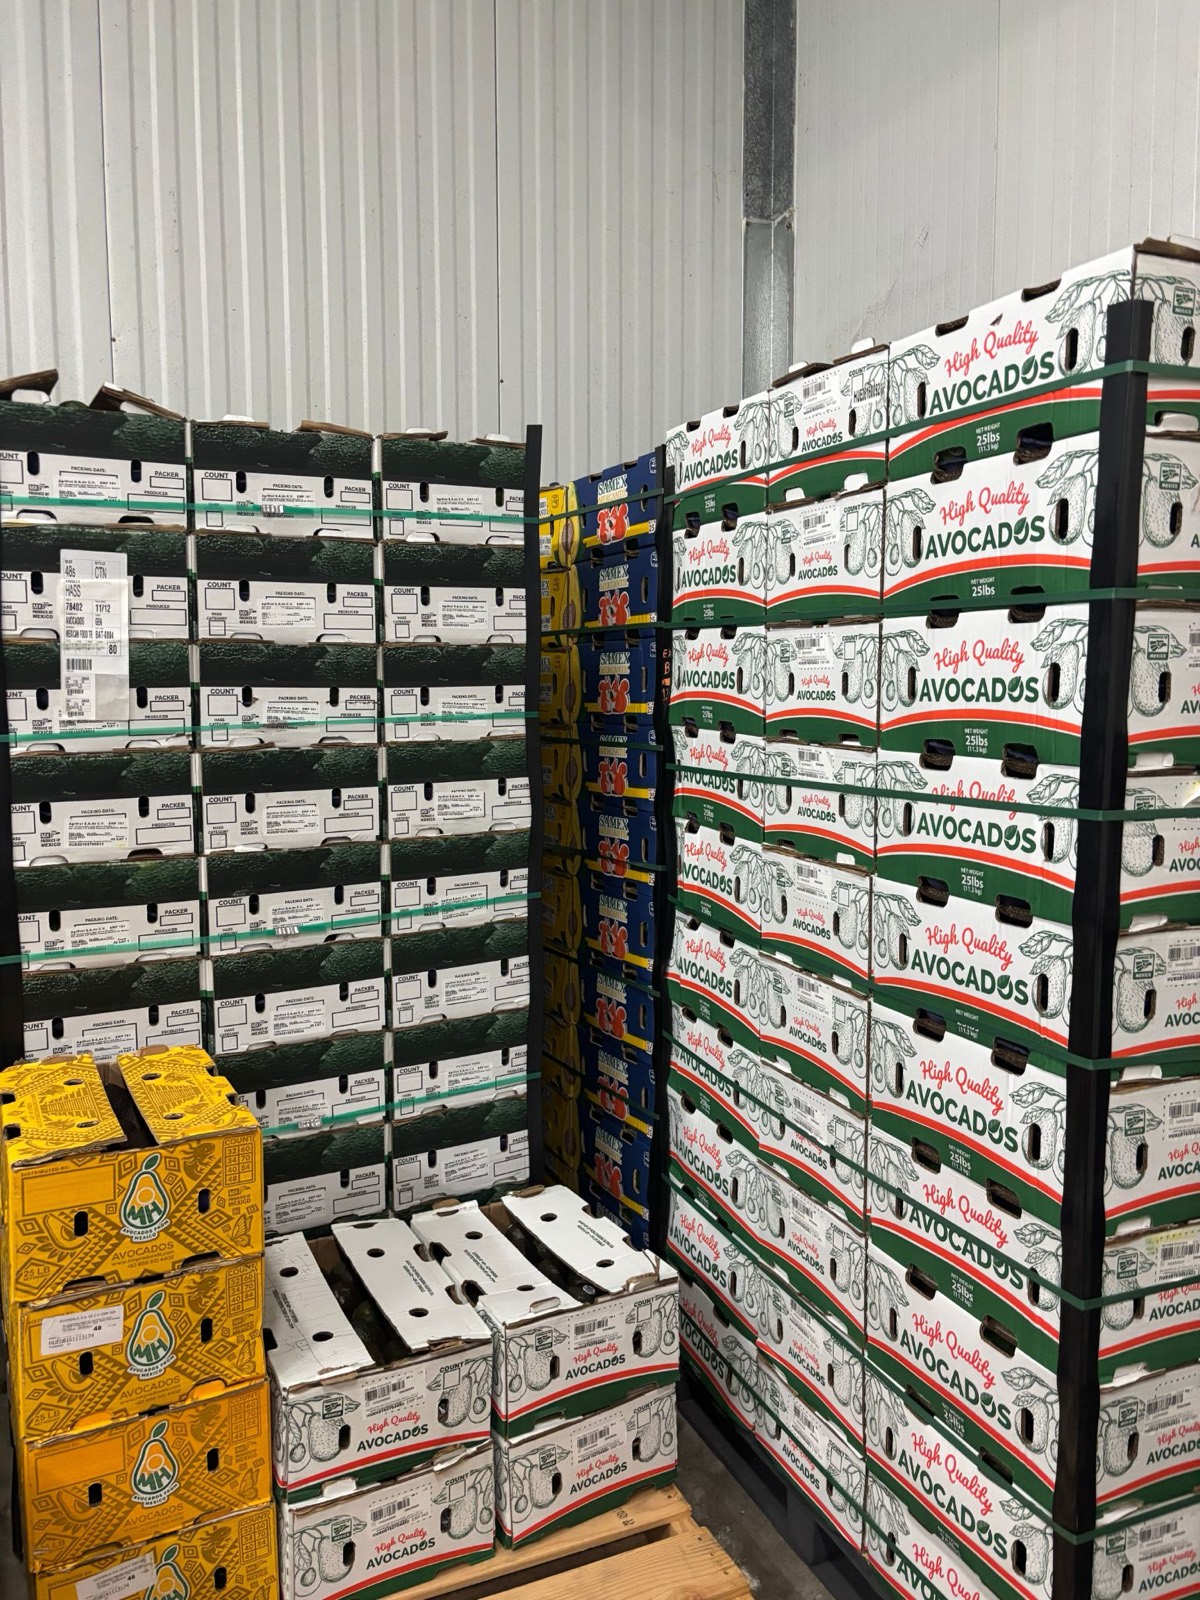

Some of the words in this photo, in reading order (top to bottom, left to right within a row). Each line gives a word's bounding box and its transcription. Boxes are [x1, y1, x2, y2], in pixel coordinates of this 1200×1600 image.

[944, 337, 981, 377] High
[982, 319, 1039, 359] Quality
[848, 366, 866, 377] COUNT
[929, 351, 1054, 415] AVOCADOS
[806, 423, 818, 437] High
[819, 418, 837, 432] Quality
[976, 432, 1001, 445] 25lbs
[691, 433, 706, 457] High
[707, 424, 732, 451] Quality
[801, 431, 843, 453] AVOCADOS
[683, 449, 738, 483] AVOCADOS
[598, 474, 627, 495] SAMEX
[844, 505, 861, 513] COUNT
[939, 497, 976, 526] High
[977, 480, 1030, 516] Quality
[925, 515, 1045, 560] AVOCADOS
[688, 545, 706, 566] High
[707, 538, 730, 562] Quality
[802, 553, 814, 566] High
[814, 550, 832, 563] Quality
[95, 566, 107, 579] CTN
[681, 564, 736, 588] AVOCADOS
[798, 565, 838, 581] AVOCADOS
[66, 584, 80, 598] HASS
[971, 585, 996, 597] 25lbs
[66, 602, 82, 612] 78402
[95, 604, 110, 612] 11/12
[108, 644, 118, 654] 80
[688, 645, 705, 667] High
[706, 643, 730, 667] Quality
[933, 639, 969, 673] High
[972, 637, 1025, 673] Quality
[681, 669, 736, 690] AVOCADOS
[801, 676, 813, 688] High
[813, 674, 830, 688] Quality
[919, 675, 1040, 703] AVOCADOS
[797, 690, 836, 701] AVOCADOS
[965, 735, 988, 747] 25lbs
[689, 744, 705, 766] High
[706, 747, 729, 773] Quality
[801, 794, 813, 805] High
[813, 794, 831, 810] Quality
[797, 806, 837, 823] AVOCADOS
[916, 811, 1037, 854] AVOCADOS
[961, 874, 984, 889] 25lbs
[218, 898, 242, 906] COUNT
[796, 908, 808, 920] High
[808, 909, 826, 926] Quality
[792, 918, 831, 940] AVOCADOS
[685, 939, 704, 958] High
[704, 940, 727, 976] Quality
[925, 923, 959, 954] High
[961, 927, 1013, 972] Quality
[678, 957, 733, 999] AVOCADOS
[911, 949, 1029, 1006] AVOCADOS
[220, 999, 244, 1007] COUNT
[1176, 993, 1198, 1009] High
[788, 1026, 827, 1054] AVOCADOS
[920, 1060, 953, 1091] High
[955, 1066, 1004, 1116] Quality
[905, 1079, 1019, 1153] AVOCADOS
[224, 1136, 253, 1146] COUNT
[682, 1125, 699, 1149] High
[699, 1133, 722, 1171] Quality
[1168, 1143, 1188, 1161] High
[241, 1154, 250, 1162] 70
[398, 1156, 418, 1164] COUNT
[679, 1140, 729, 1197] AVOCADOS
[949, 1151, 972, 1170] 25lbs
[923, 1183, 955, 1216] High
[957, 1194, 1009, 1248] Quality
[112, 1242, 174, 1260] AVOCADOS
[38, 1266, 50, 1274] LB
[227, 1265, 256, 1276] COUNT
[951, 1279, 974, 1301] 25lbs
[634, 1296, 655, 1307] COUNT
[573, 1351, 593, 1364] High
[593, 1344, 619, 1358] Quality
[911, 1312, 943, 1346] High
[945, 1330, 996, 1389] Quality
[440, 1362, 464, 1373] COUNT
[565, 1354, 626, 1380] AVOCADOS
[120, 1376, 181, 1400] AVOCADOS
[900, 1329, 1012, 1431] AVOCADOS
[634, 1402, 653, 1414] COUNT
[367, 1420, 389, 1434] High
[391, 1411, 421, 1425] Quality
[357, 1424, 428, 1452] AVOCADOS
[576, 1465, 594, 1479] High
[594, 1454, 620, 1469] Quality
[911, 1432, 942, 1467] High
[944, 1453, 993, 1515] Quality
[445, 1473, 469, 1486] COUNT
[570, 1462, 628, 1495] AVOCADOS
[898, 1448, 1008, 1560] AVOCADOS
[124, 1504, 184, 1528] AVOCADOS
[375, 1539, 397, 1554] High
[397, 1528, 428, 1544] Quality
[366, 1538, 436, 1570] AVOCADOS
[912, 1543, 945, 1578] High
